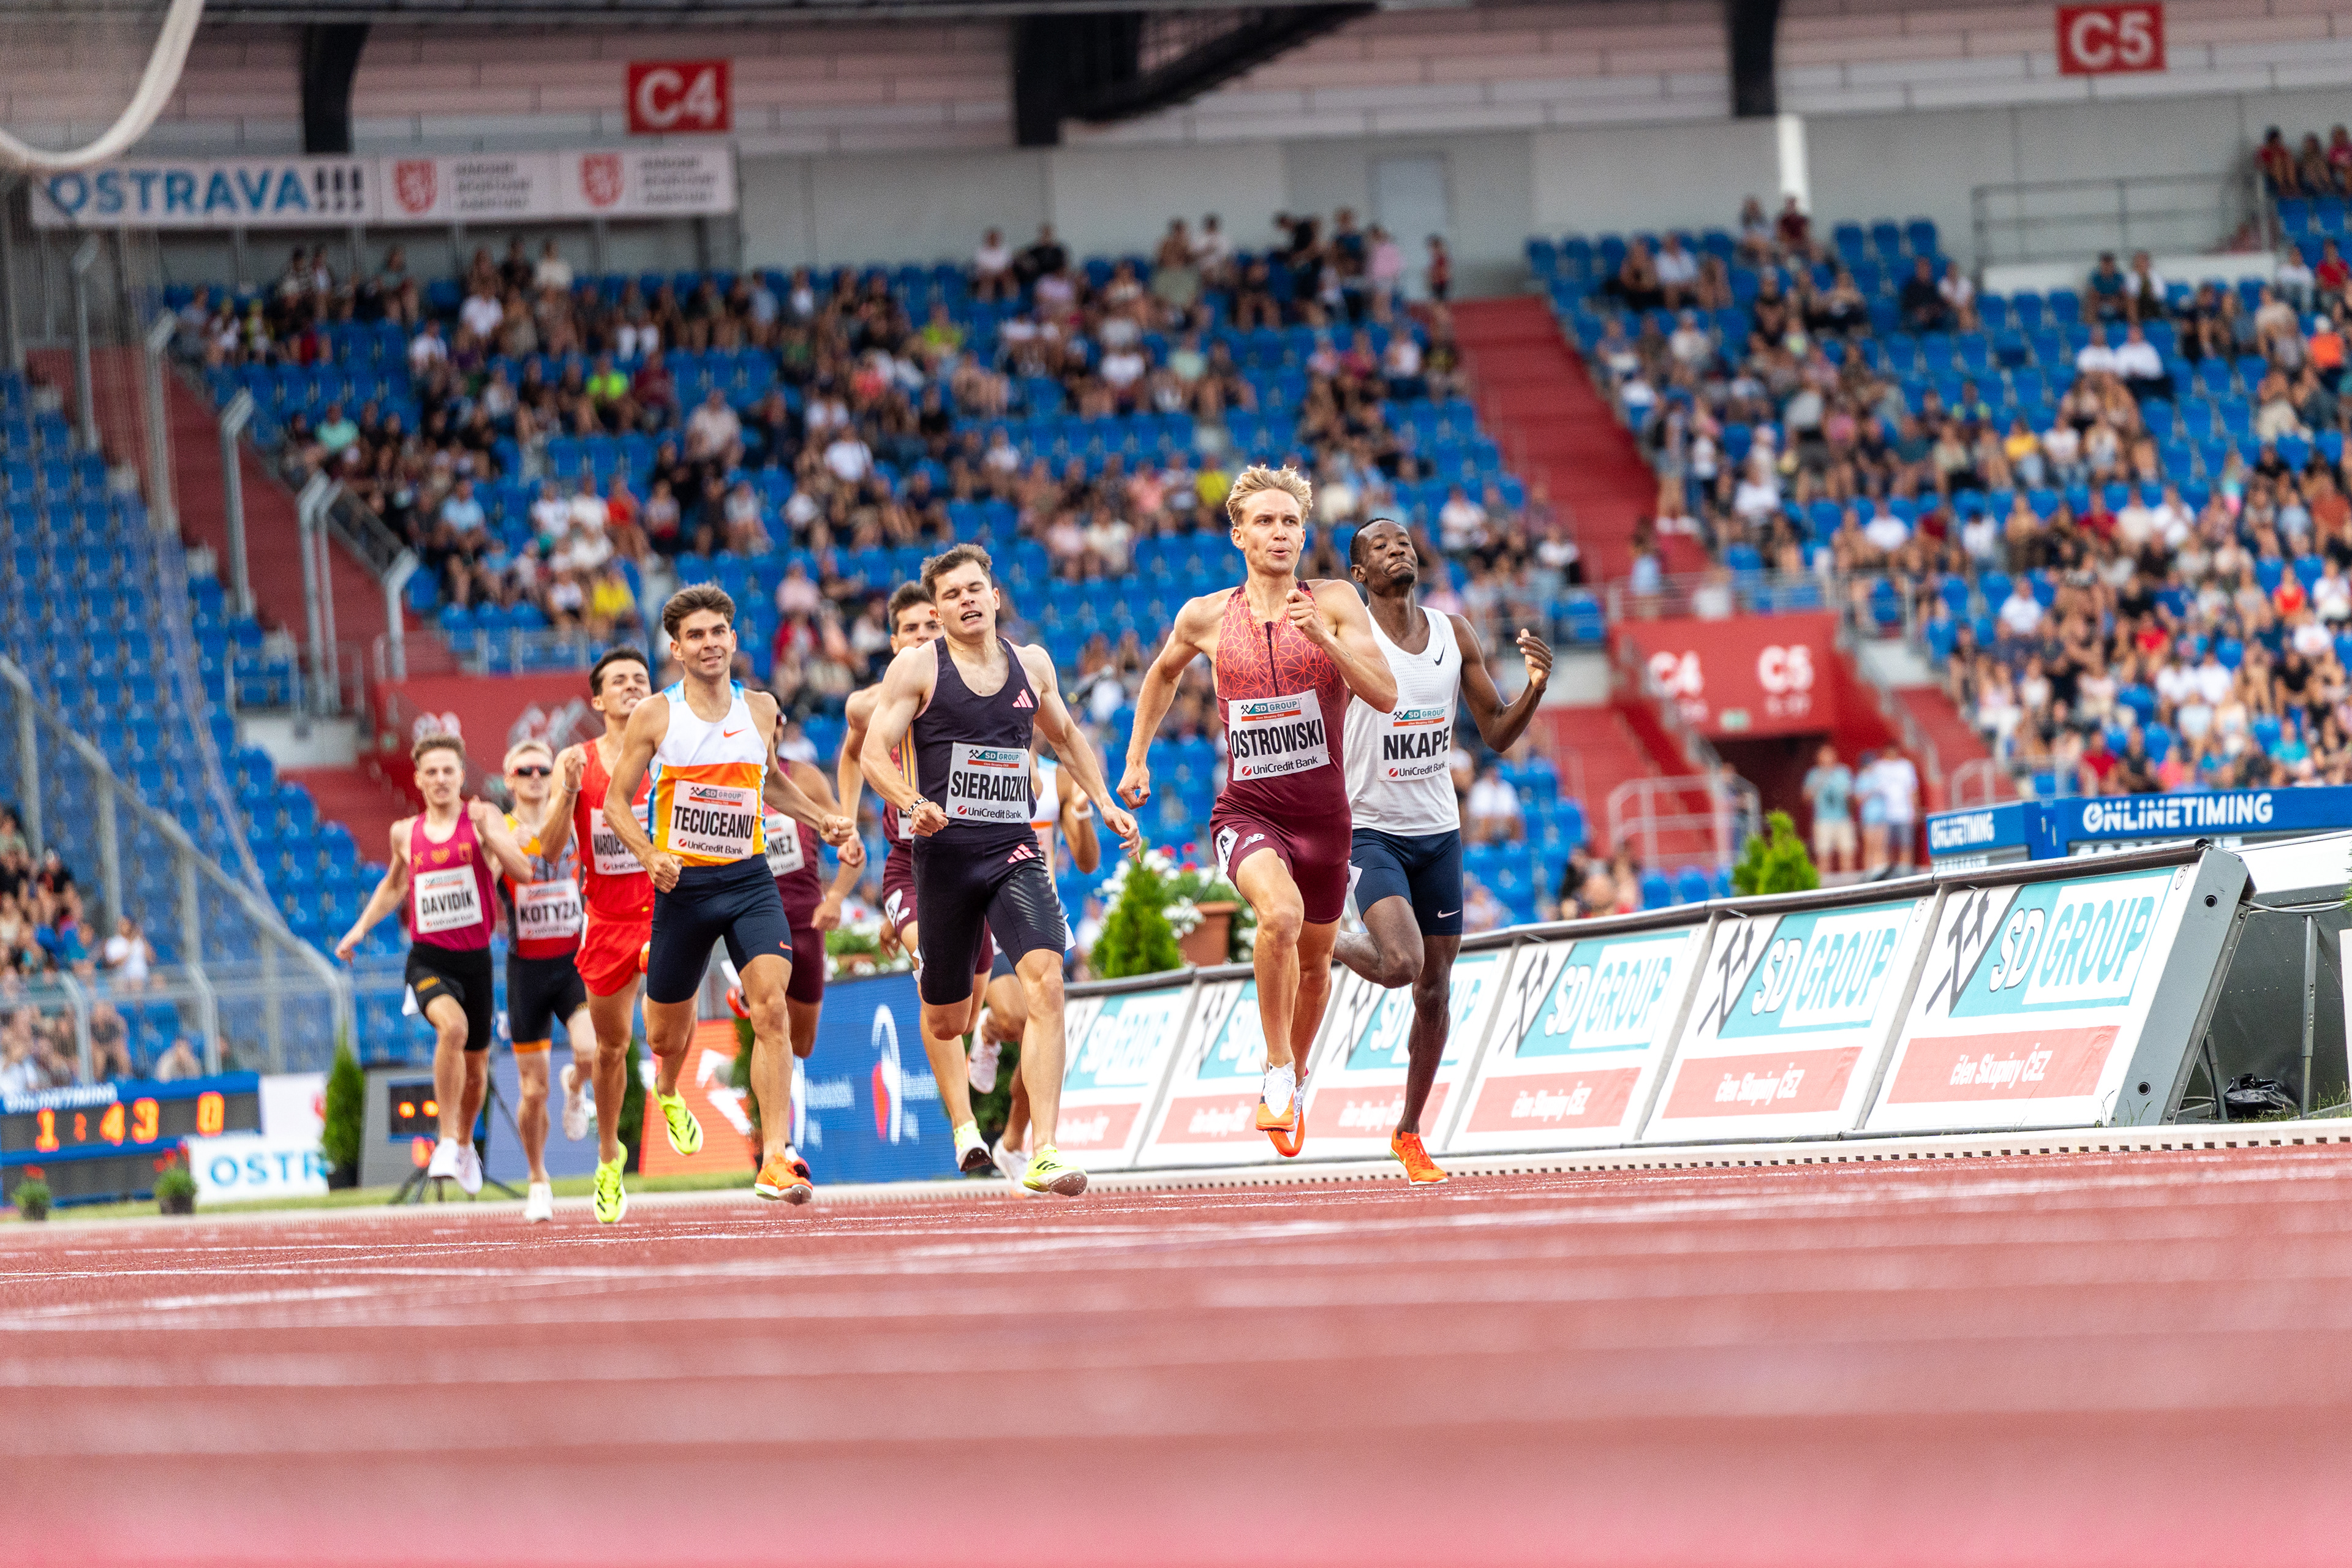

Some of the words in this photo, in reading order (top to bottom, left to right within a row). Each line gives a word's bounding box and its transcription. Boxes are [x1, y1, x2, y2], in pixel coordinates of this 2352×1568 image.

[2070, 11, 2154, 67] C5
[635, 67, 721, 127] C4
[1270, 701, 1297, 711] GROUP
[1422, 708, 1444, 717] GROUP
[1231, 718, 1325, 759] OSTROWSKI
[1383, 726, 1450, 760] NKAPE
[1253, 761, 1294, 775] UniCredit
[1295, 756, 1318, 769] Bank
[1399, 765, 1433, 777] UniCredit
[1433, 761, 1446, 772] Bank
[718, 790, 742, 800] GROUP
[951, 771, 1027, 802] SIERADZKI
[674, 805, 755, 840] TECUCEANU
[968, 807, 1005, 819] UniCredit
[1006, 810, 1023, 819] Bank
[688, 841, 723, 854] UniCredit
[725, 845, 743, 856] Bank
[422, 887, 475, 916] DAVIDÍK
[1989, 908, 2046, 993] SD
[2038, 896, 2155, 989] GROUP
[1751, 938, 1803, 1016] SD
[1795, 928, 1897, 1011] GROUP
[1545, 963, 1592, 1038] SD
[1585, 957, 1672, 1033] GROUP
[1950, 1054, 1978, 1087] člen
[1975, 1052, 2025, 1090] Skupiny
[2021, 1042, 2053, 1082] ČEZ
